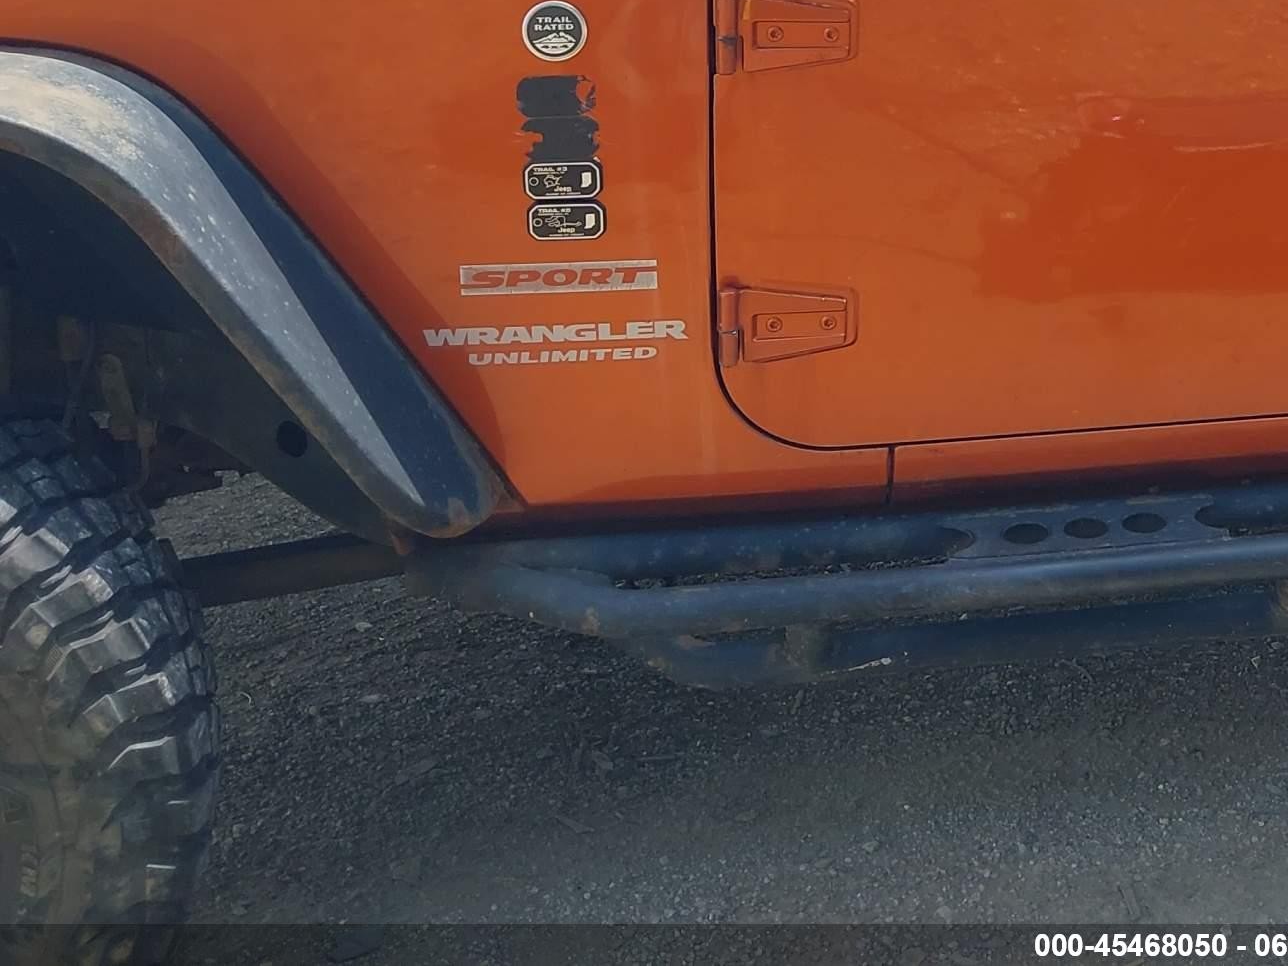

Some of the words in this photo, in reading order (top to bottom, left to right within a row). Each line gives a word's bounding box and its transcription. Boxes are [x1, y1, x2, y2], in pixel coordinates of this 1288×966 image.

[553, 185, 573, 193] Jeep
[557, 226, 576, 234] Jeep
[461, 266, 657, 289] SPORT
[423, 320, 688, 346] WRANGLER
[469, 347, 657, 365] UNLIMITED
